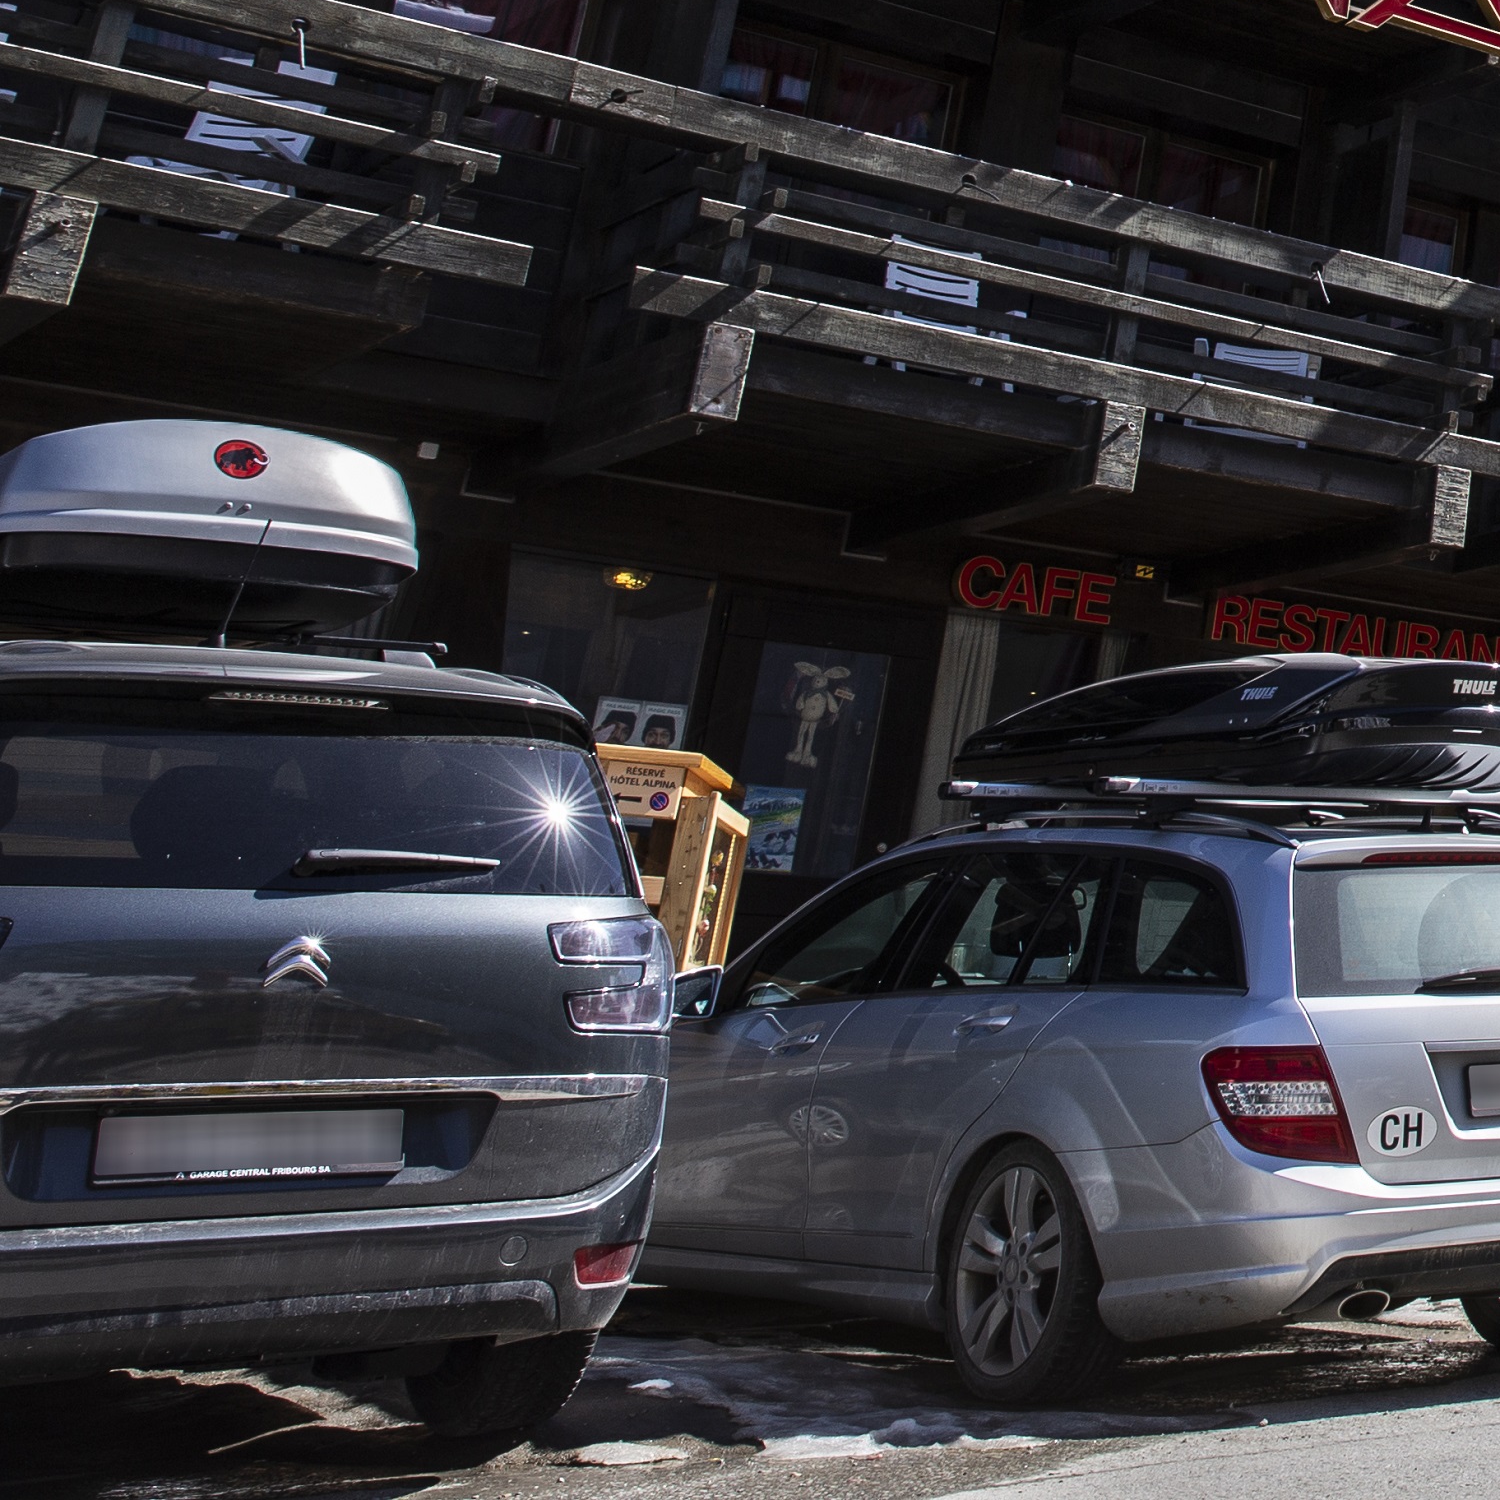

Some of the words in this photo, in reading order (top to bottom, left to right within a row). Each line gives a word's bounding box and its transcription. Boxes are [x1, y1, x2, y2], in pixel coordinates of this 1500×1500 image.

[954, 555, 1118, 626] CAFE
[1240, 686, 1279, 700] THULE
[1453, 679, 1498, 695] THULE
[626, 766, 666, 778] RÉSERVÉ
[610, 776, 640, 786] HÔTEL
[642, 779, 677, 789] ALPINA
[1380, 1112, 1424, 1149] CH
[190, 1170, 228, 1179] GARAGE
[230, 1168, 270, 1177] CENTRAL
[272, 1166, 317, 1176] FRIBOURG
[318, 1165, 331, 1173] SA
